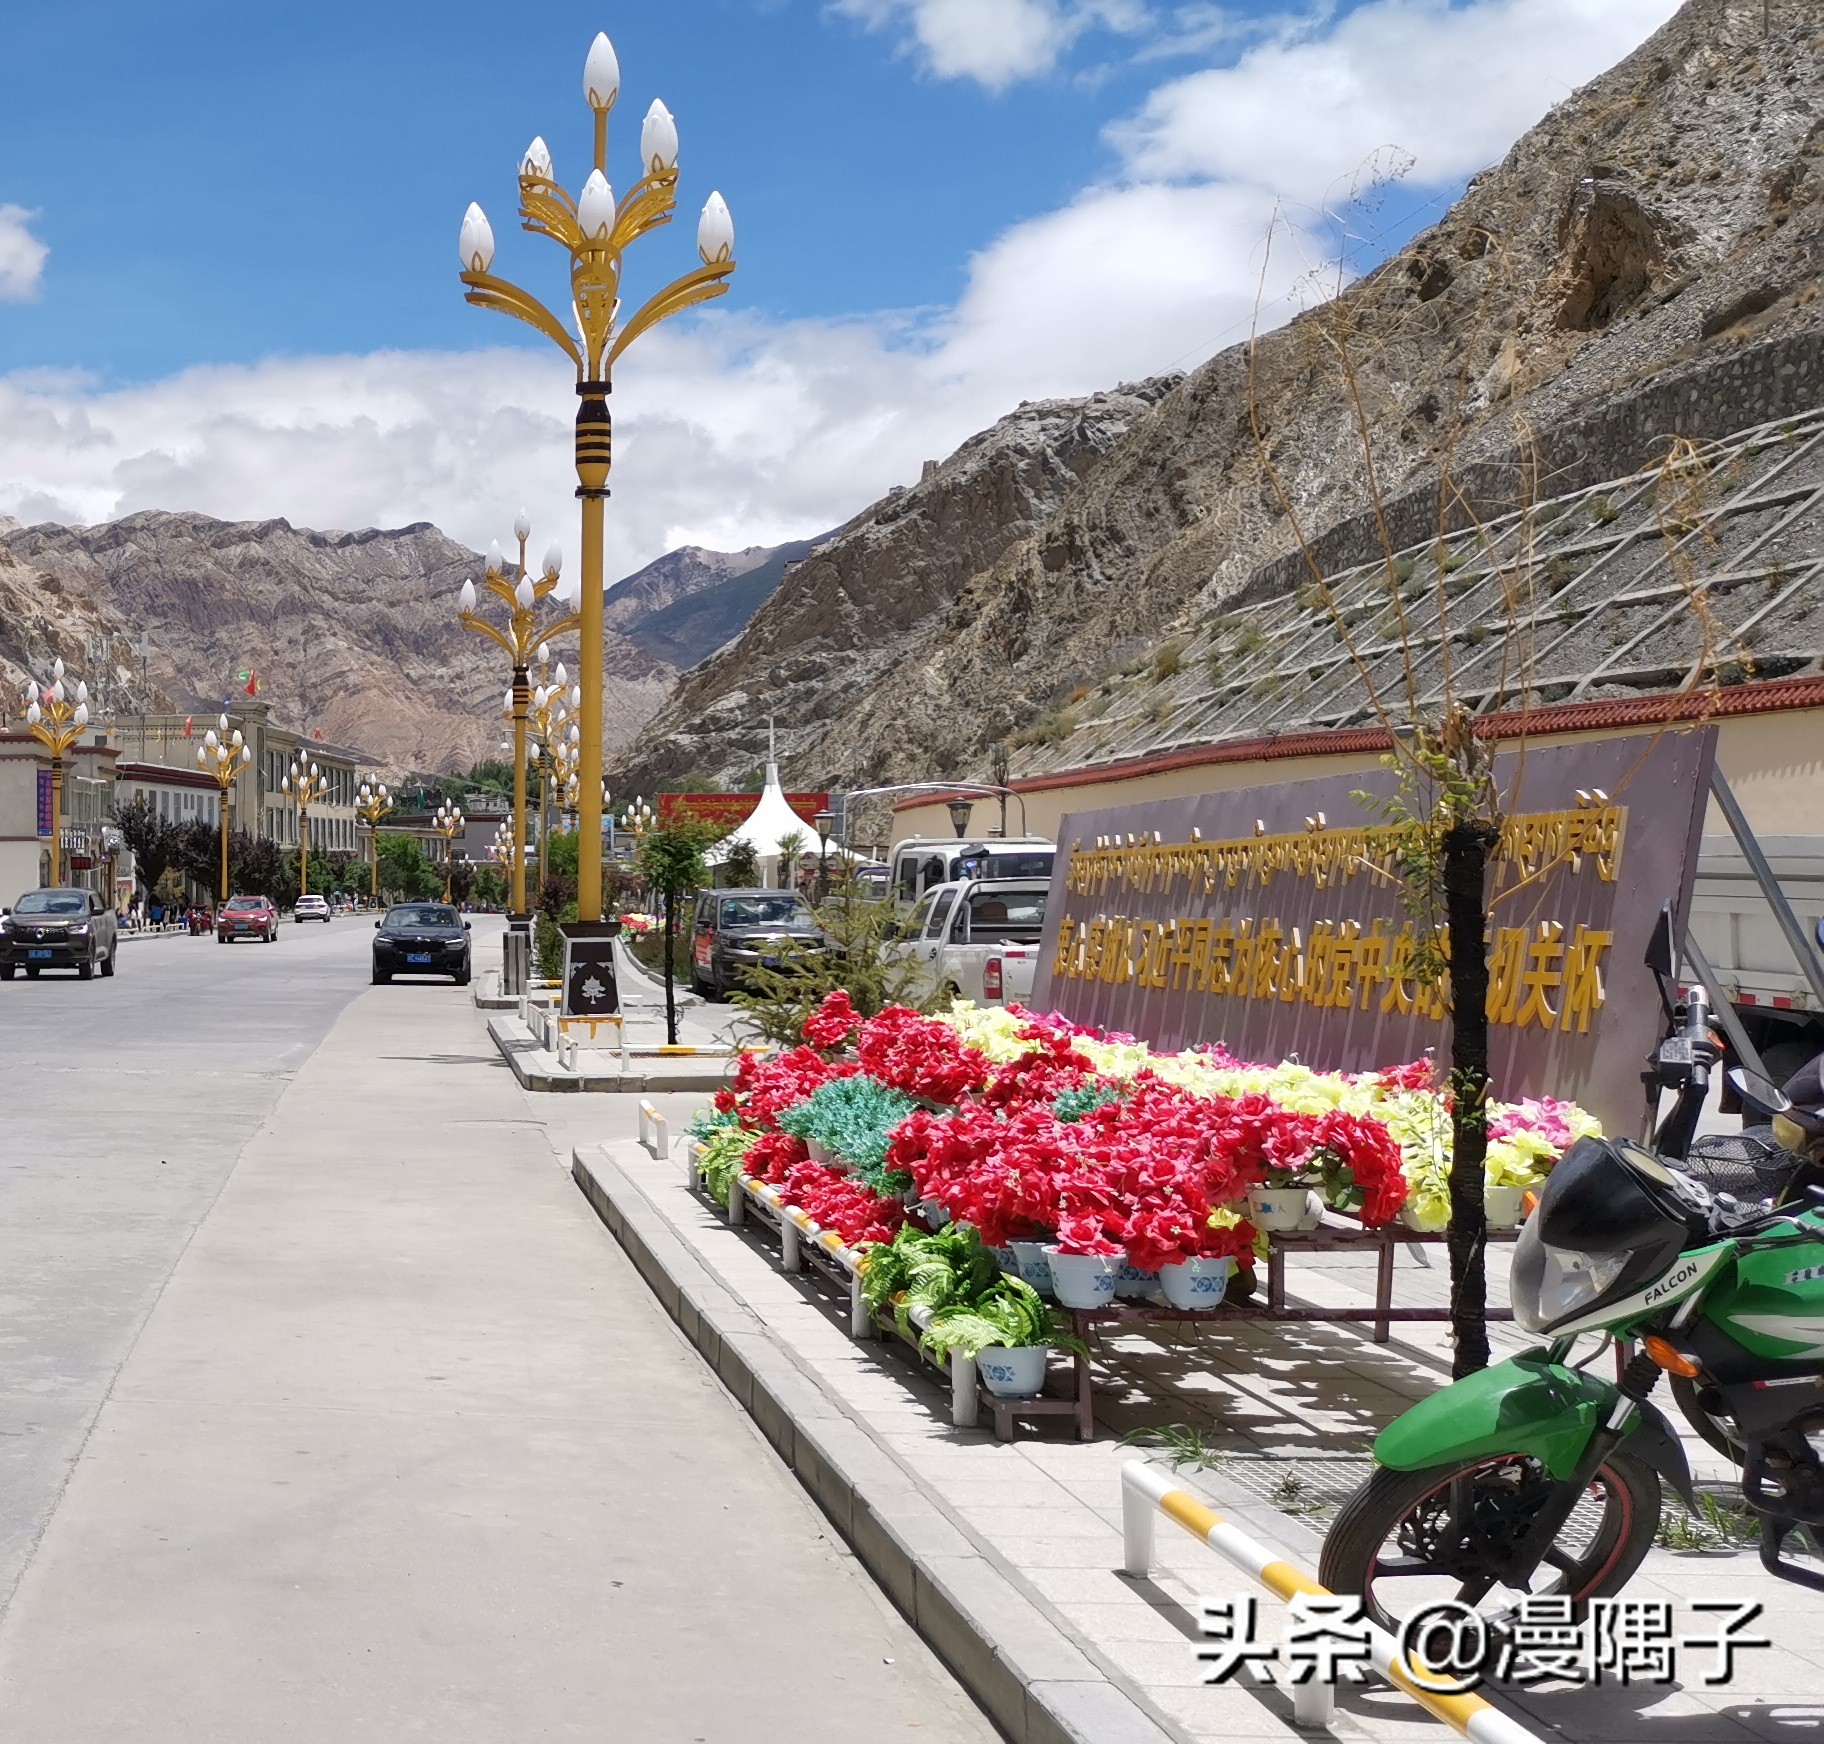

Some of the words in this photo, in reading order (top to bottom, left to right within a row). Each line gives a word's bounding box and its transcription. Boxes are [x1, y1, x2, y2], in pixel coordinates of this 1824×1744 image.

[1053, 911, 1613, 1034] 衷心感谢以习近平同志为核心的党中央的切关怀
[1643, 1261, 1698, 1306] FALCON
